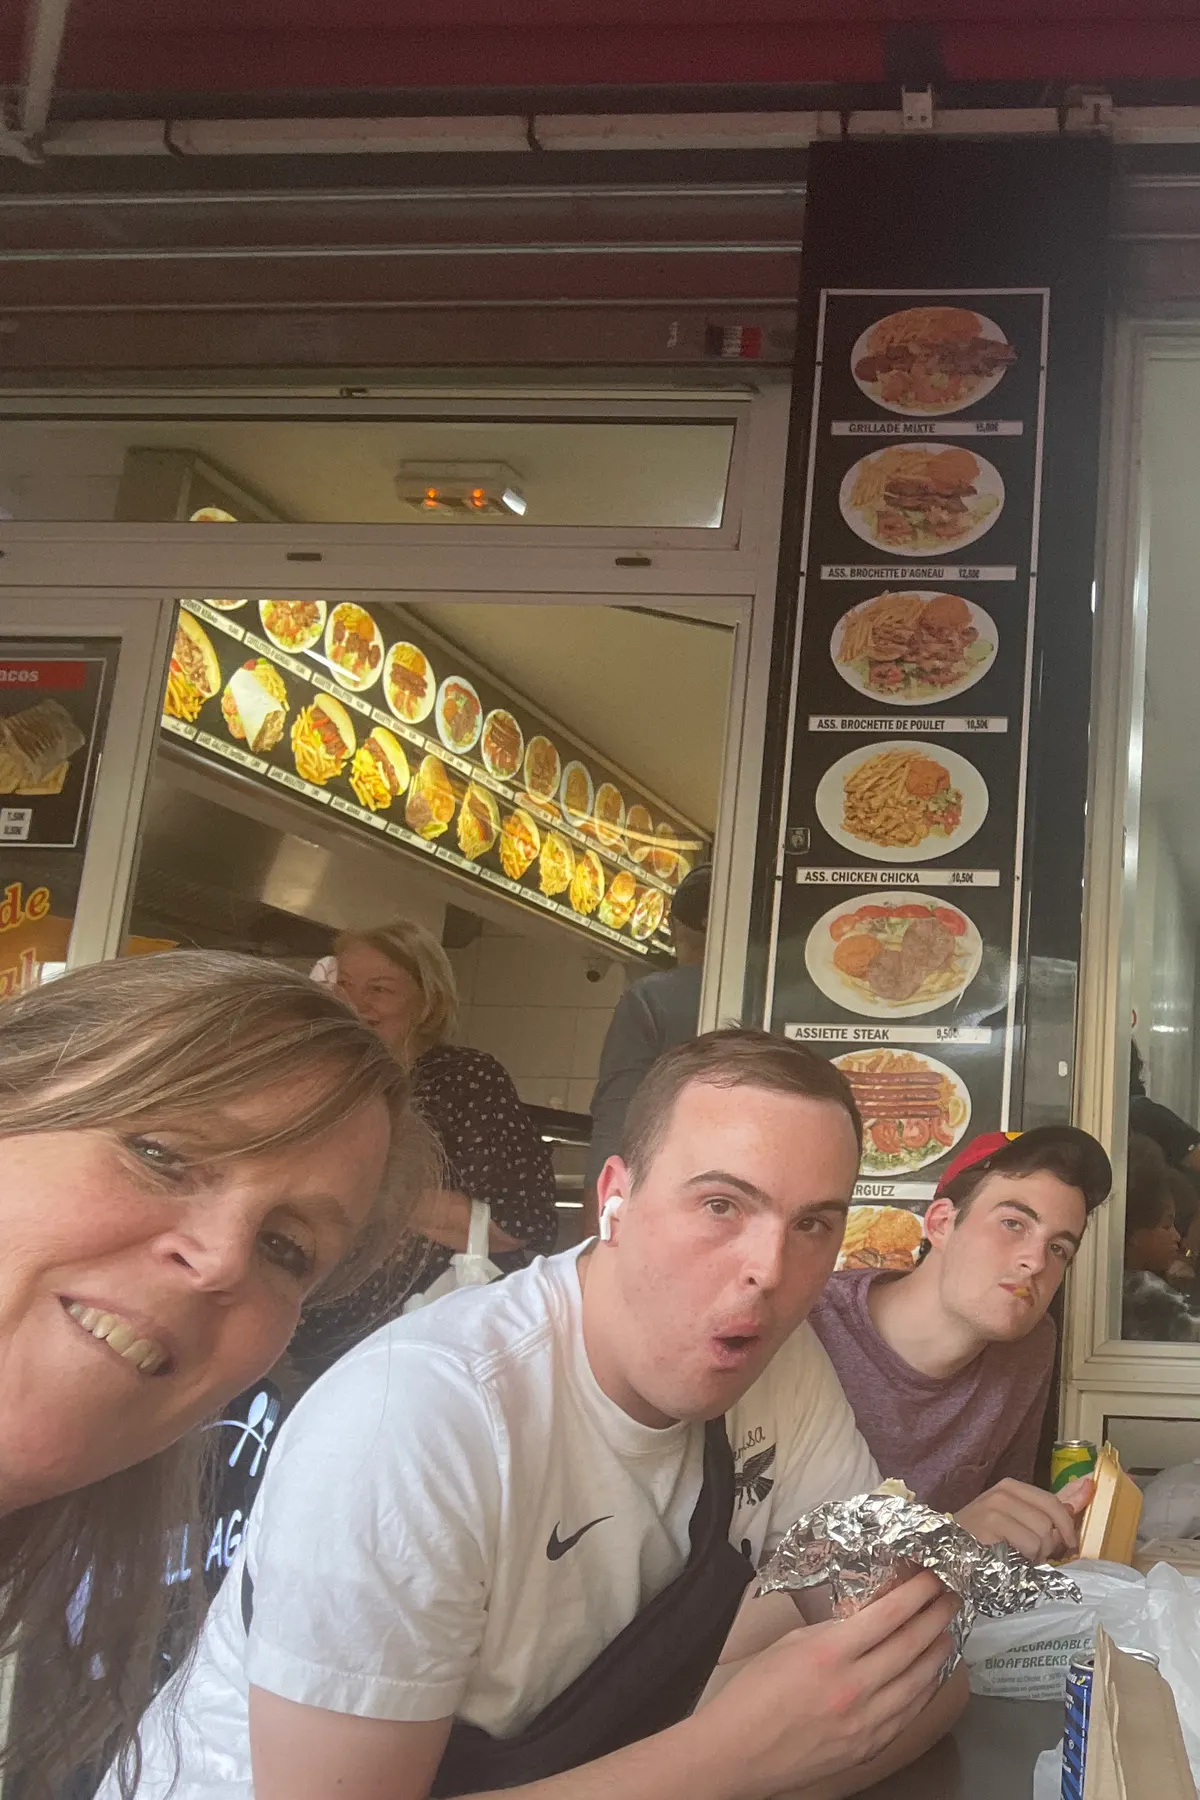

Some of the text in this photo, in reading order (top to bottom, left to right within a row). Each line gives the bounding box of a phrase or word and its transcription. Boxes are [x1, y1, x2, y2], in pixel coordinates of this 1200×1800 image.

[848, 422, 902, 434] GRILLADE
[903, 422, 936, 434] MIXTE
[827, 568, 848, 579] ASS.
[849, 568, 900, 579] BROCHETTE
[900, 568, 945, 578] D'AGNEAU
[816, 719, 839, 730] ASS.
[840, 719, 894, 731] BROCHETTE
[895, 720, 909, 731] DE
[909, 720, 946, 731] POULET
[804, 871, 829, 883] ASS.
[831, 871, 878, 883] CHICKEN
[880, 872, 920, 884] CHICKA
[795, 1027, 848, 1040] ASSIETTE
[852, 1028, 890, 1041] STEAK
[851, 1184, 896, 1198] RGUEZ
